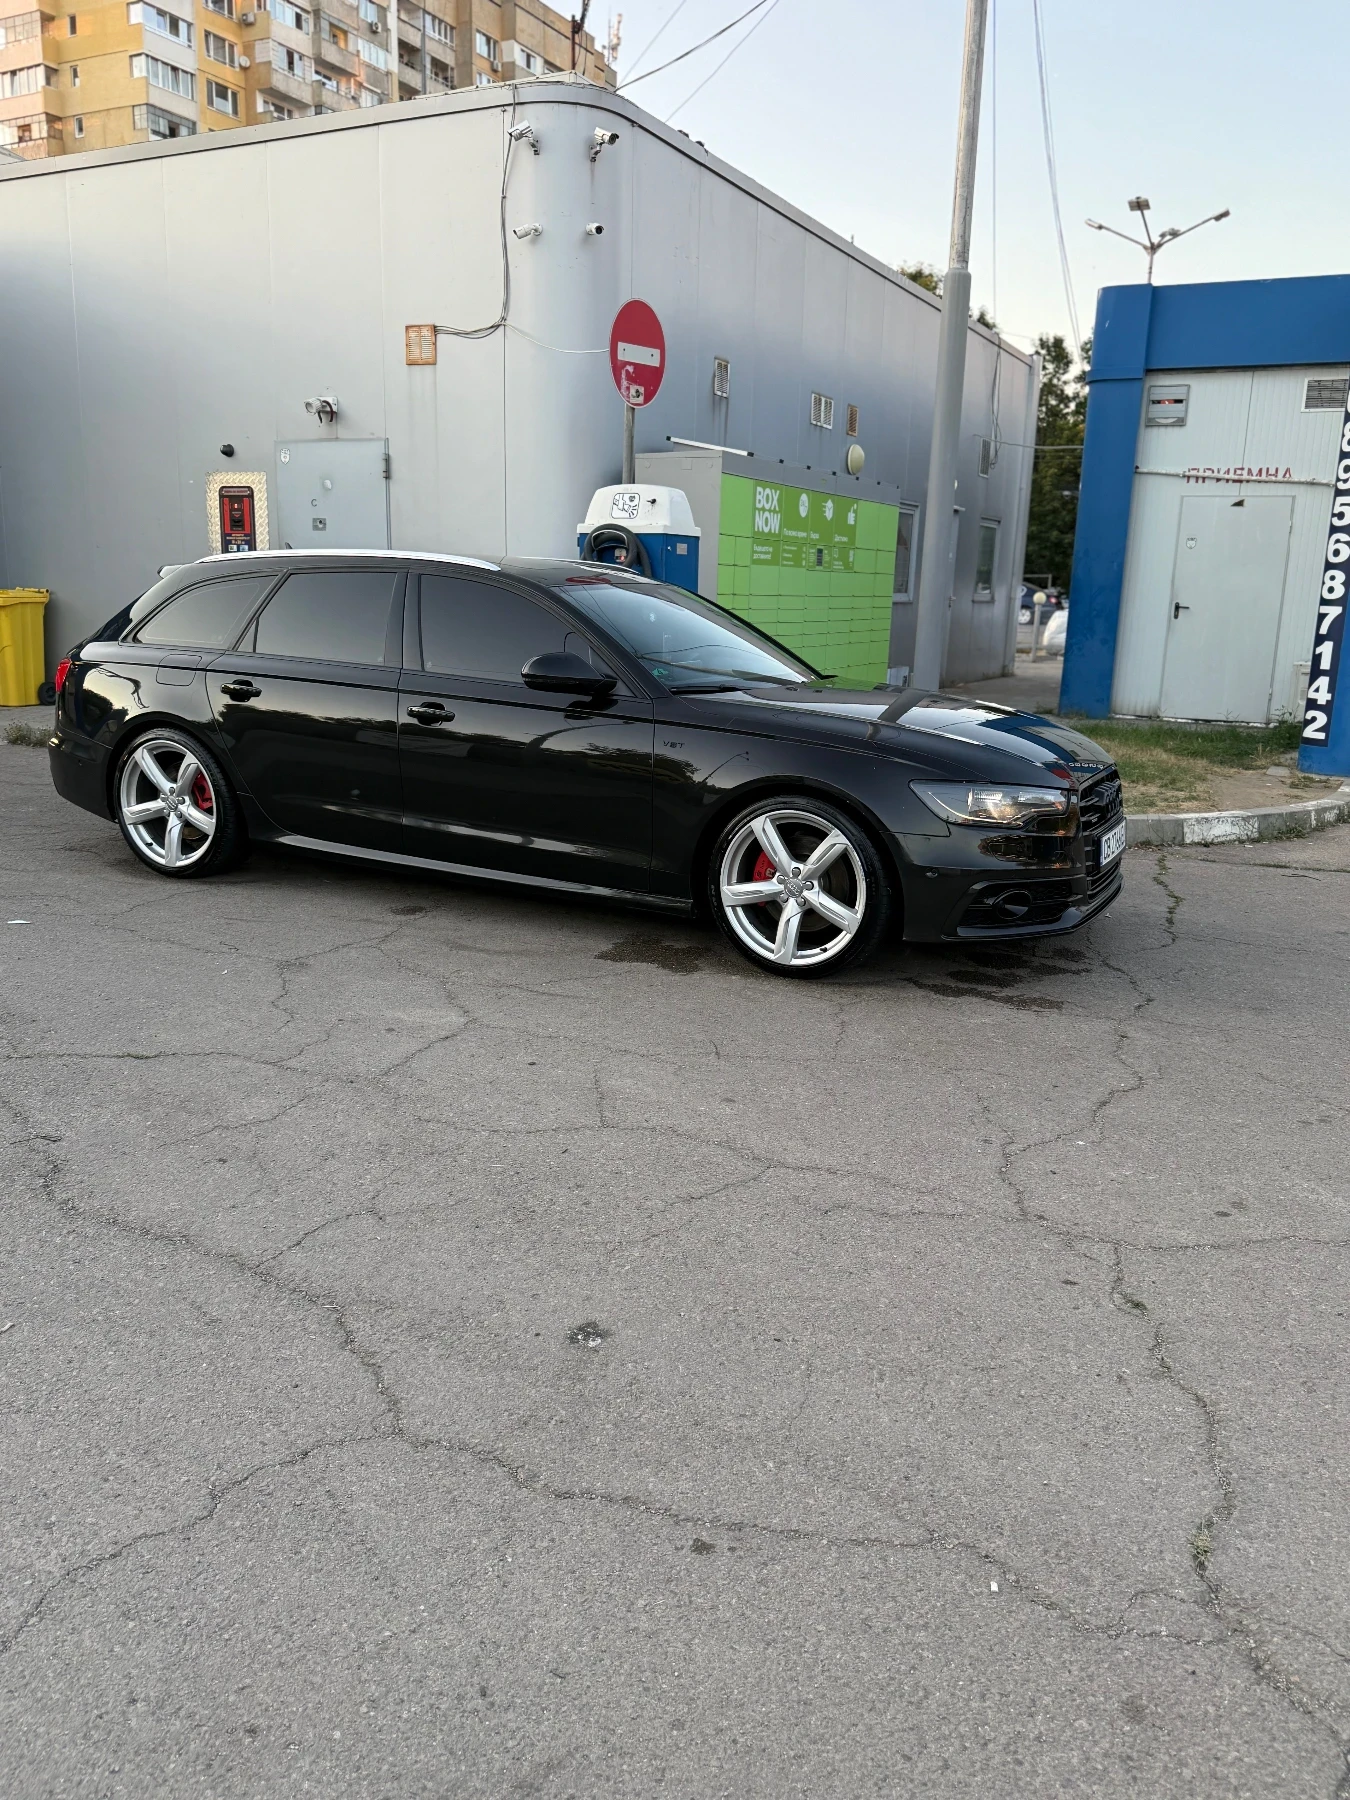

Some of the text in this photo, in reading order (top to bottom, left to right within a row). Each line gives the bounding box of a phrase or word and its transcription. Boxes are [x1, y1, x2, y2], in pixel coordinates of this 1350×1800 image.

[1186, 467, 1292, 484] ПРИЕМНА
[755, 486, 780, 511] BOX
[754, 510, 781, 534] NOW
[1302, 390, 1350, 739] 95687142
